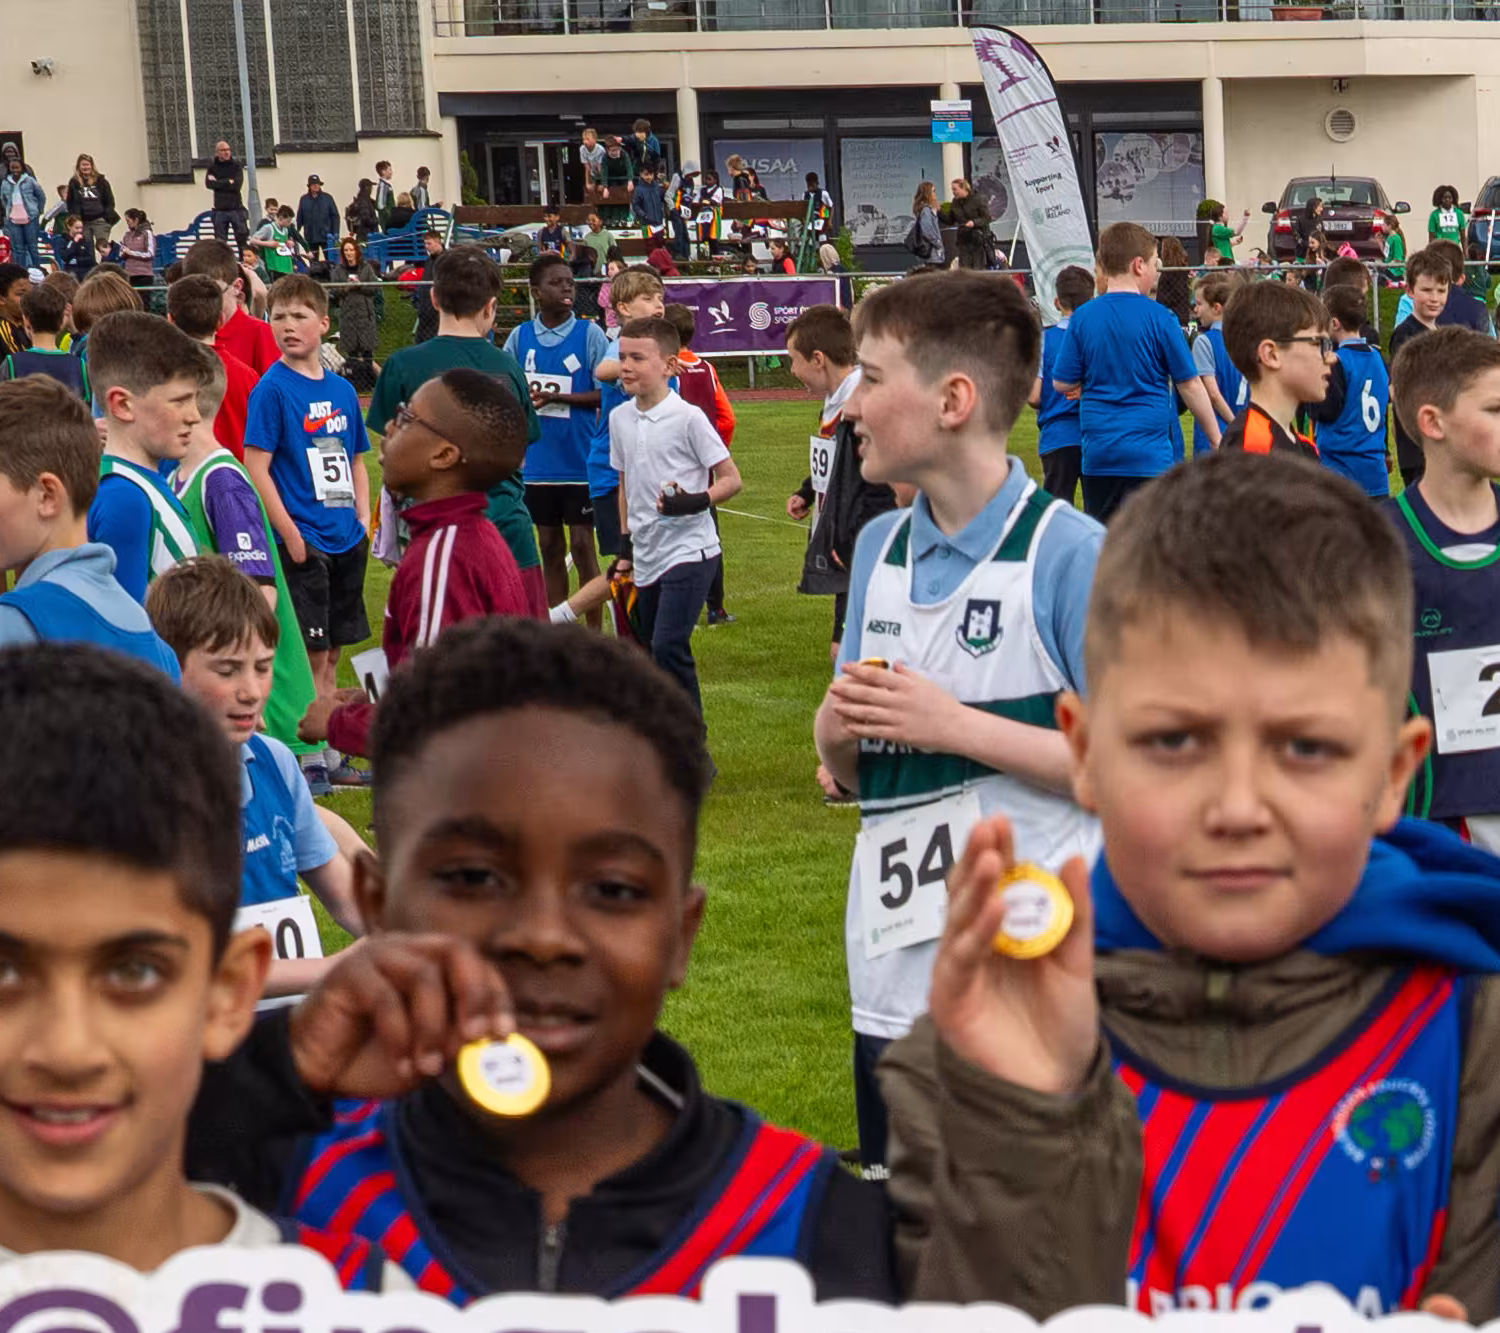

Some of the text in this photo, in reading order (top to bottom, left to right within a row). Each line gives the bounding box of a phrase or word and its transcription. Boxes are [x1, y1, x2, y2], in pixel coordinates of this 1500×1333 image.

[1024, 171, 1063, 189] Supporting
[1036, 183, 1054, 196] Sport
[308, 401, 333, 420] JUST
[1361, 379, 1380, 433] 6
[321, 456, 350, 484] 57
[812, 447, 829, 478] 59
[228, 549, 268, 564] Expedia
[880, 822, 956, 911] 54
